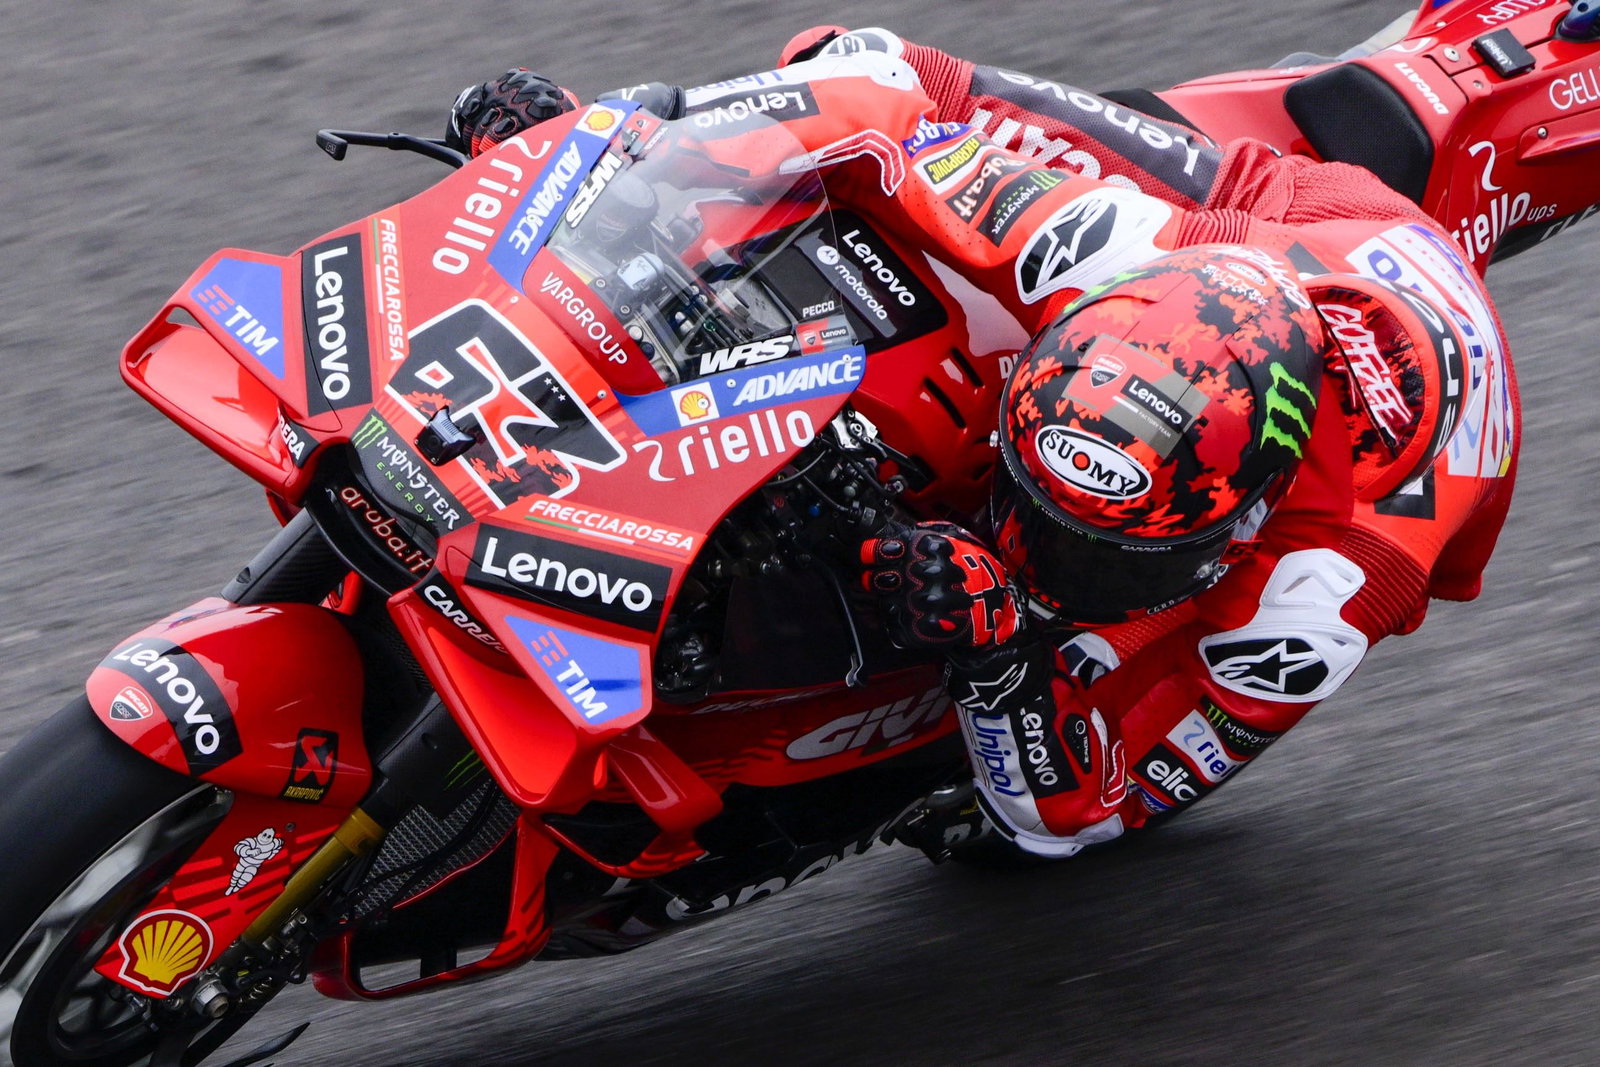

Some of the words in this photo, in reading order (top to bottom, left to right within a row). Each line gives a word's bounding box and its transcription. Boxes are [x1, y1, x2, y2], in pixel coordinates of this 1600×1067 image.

[693, 90, 807, 129] Lenovo
[997, 71, 1201, 176] Lenovo
[432, 158, 523, 275] riello
[508, 140, 583, 256] ADVANCE
[565, 151, 624, 229] WRS
[1526, 203, 1557, 223] ups
[380, 218, 405, 361] FRECCIAROSSA
[835, 264, 888, 321] motorola
[842, 229, 916, 306] Lenovo
[224, 305, 279, 357] TIM
[314, 246, 351, 401] Lenovo
[540, 271, 628, 365] VARGROUP
[802, 300, 835, 318] PECCO
[821, 327, 847, 338] Lenovo
[699, 334, 794, 376] WRS
[733, 355, 862, 407] ADVANCE
[1128, 379, 1182, 424] Lenovo
[677, 409, 816, 477] riello
[1045, 430, 1137, 497] SUOMY
[375, 461, 434, 522] ENERGY
[376, 436, 460, 530] MONSTER
[340, 486, 433, 574] aruba.it
[528, 499, 694, 551] FRECCIAROSSA
[481, 536, 653, 612] Lenovo
[112, 642, 220, 755] Lenovo
[556, 659, 608, 719] TIM
[970, 709, 1026, 797] Unipol
